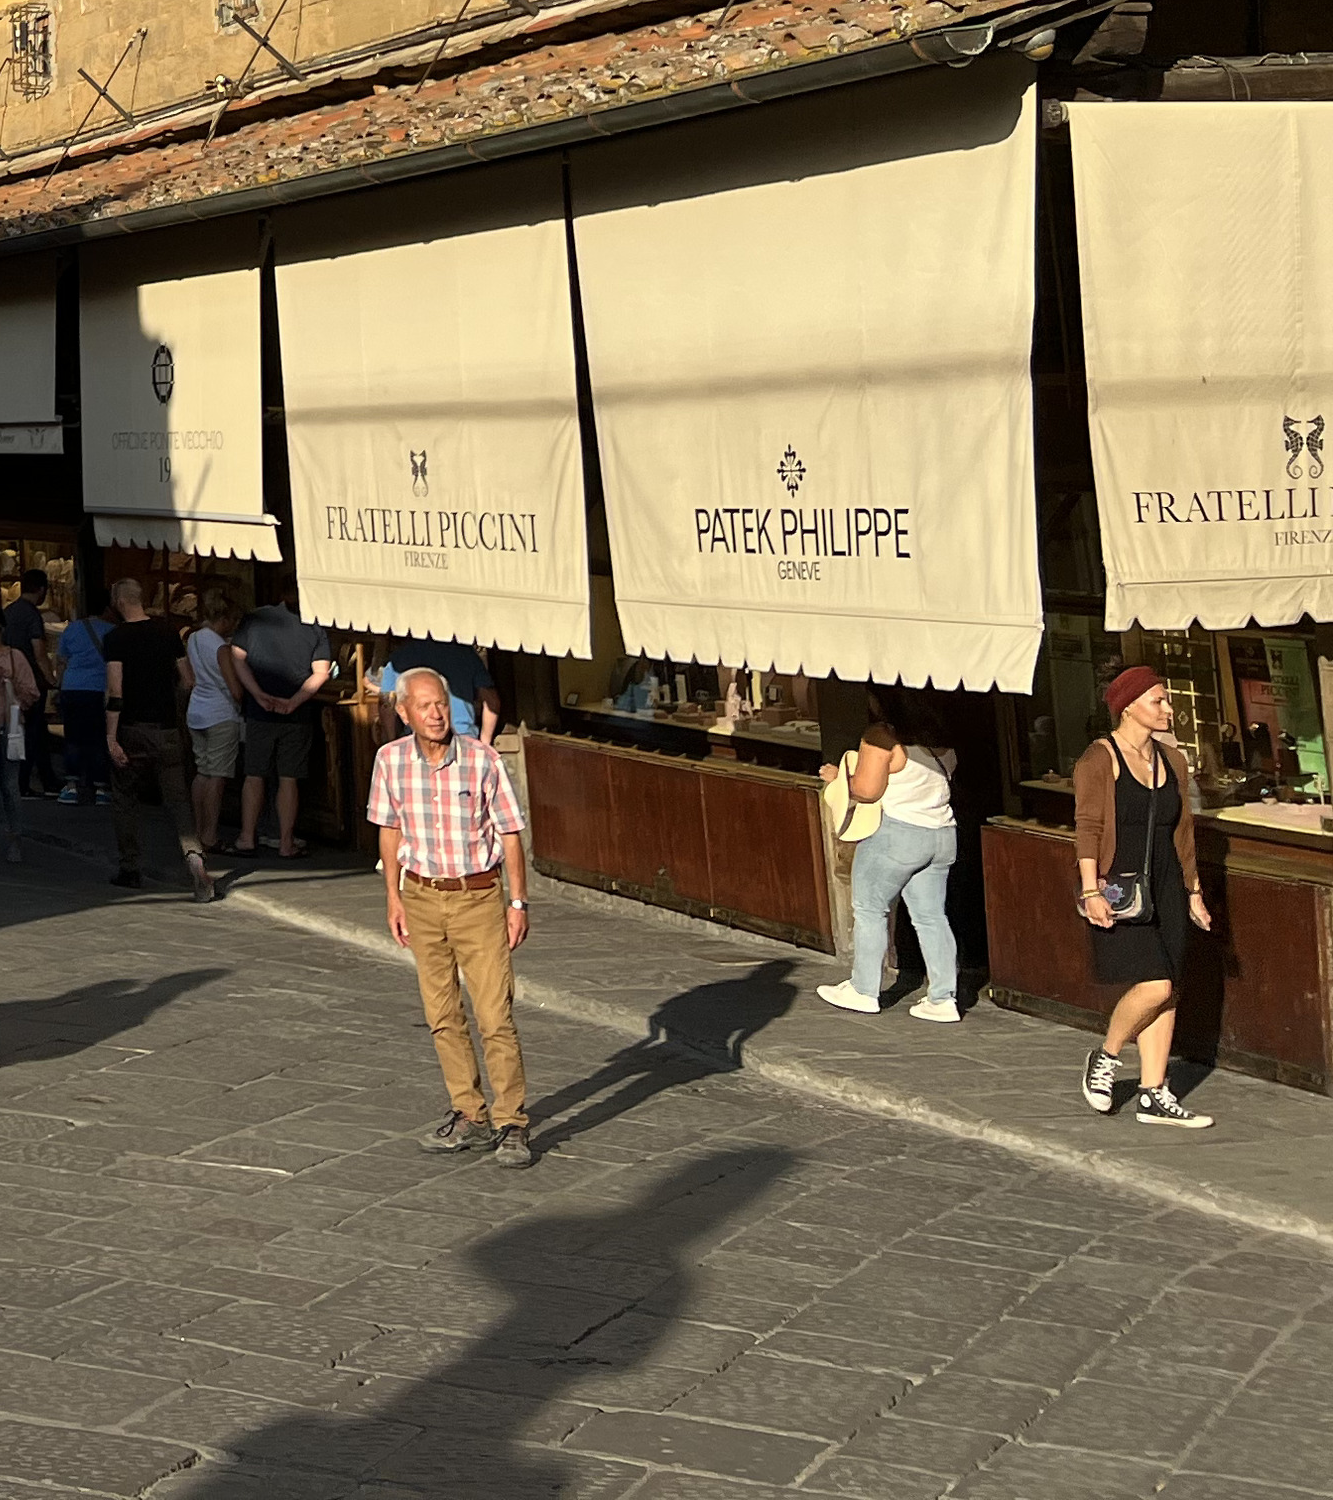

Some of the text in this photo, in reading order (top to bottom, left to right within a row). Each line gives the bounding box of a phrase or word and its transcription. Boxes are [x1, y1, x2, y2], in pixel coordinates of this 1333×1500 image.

[150, 432, 179, 450] PONTE
[180, 431, 223, 450] VECCHIO
[159, 456, 171, 483] 19
[1132, 487, 1319, 523] FRATELLI
[326, 505, 539, 553] FRATELLI PICCINI
[695, 508, 911, 558] PATEK PHILIPPE
[404, 551, 449, 570] FIRENZE
[777, 561, 821, 581] GENEVE
